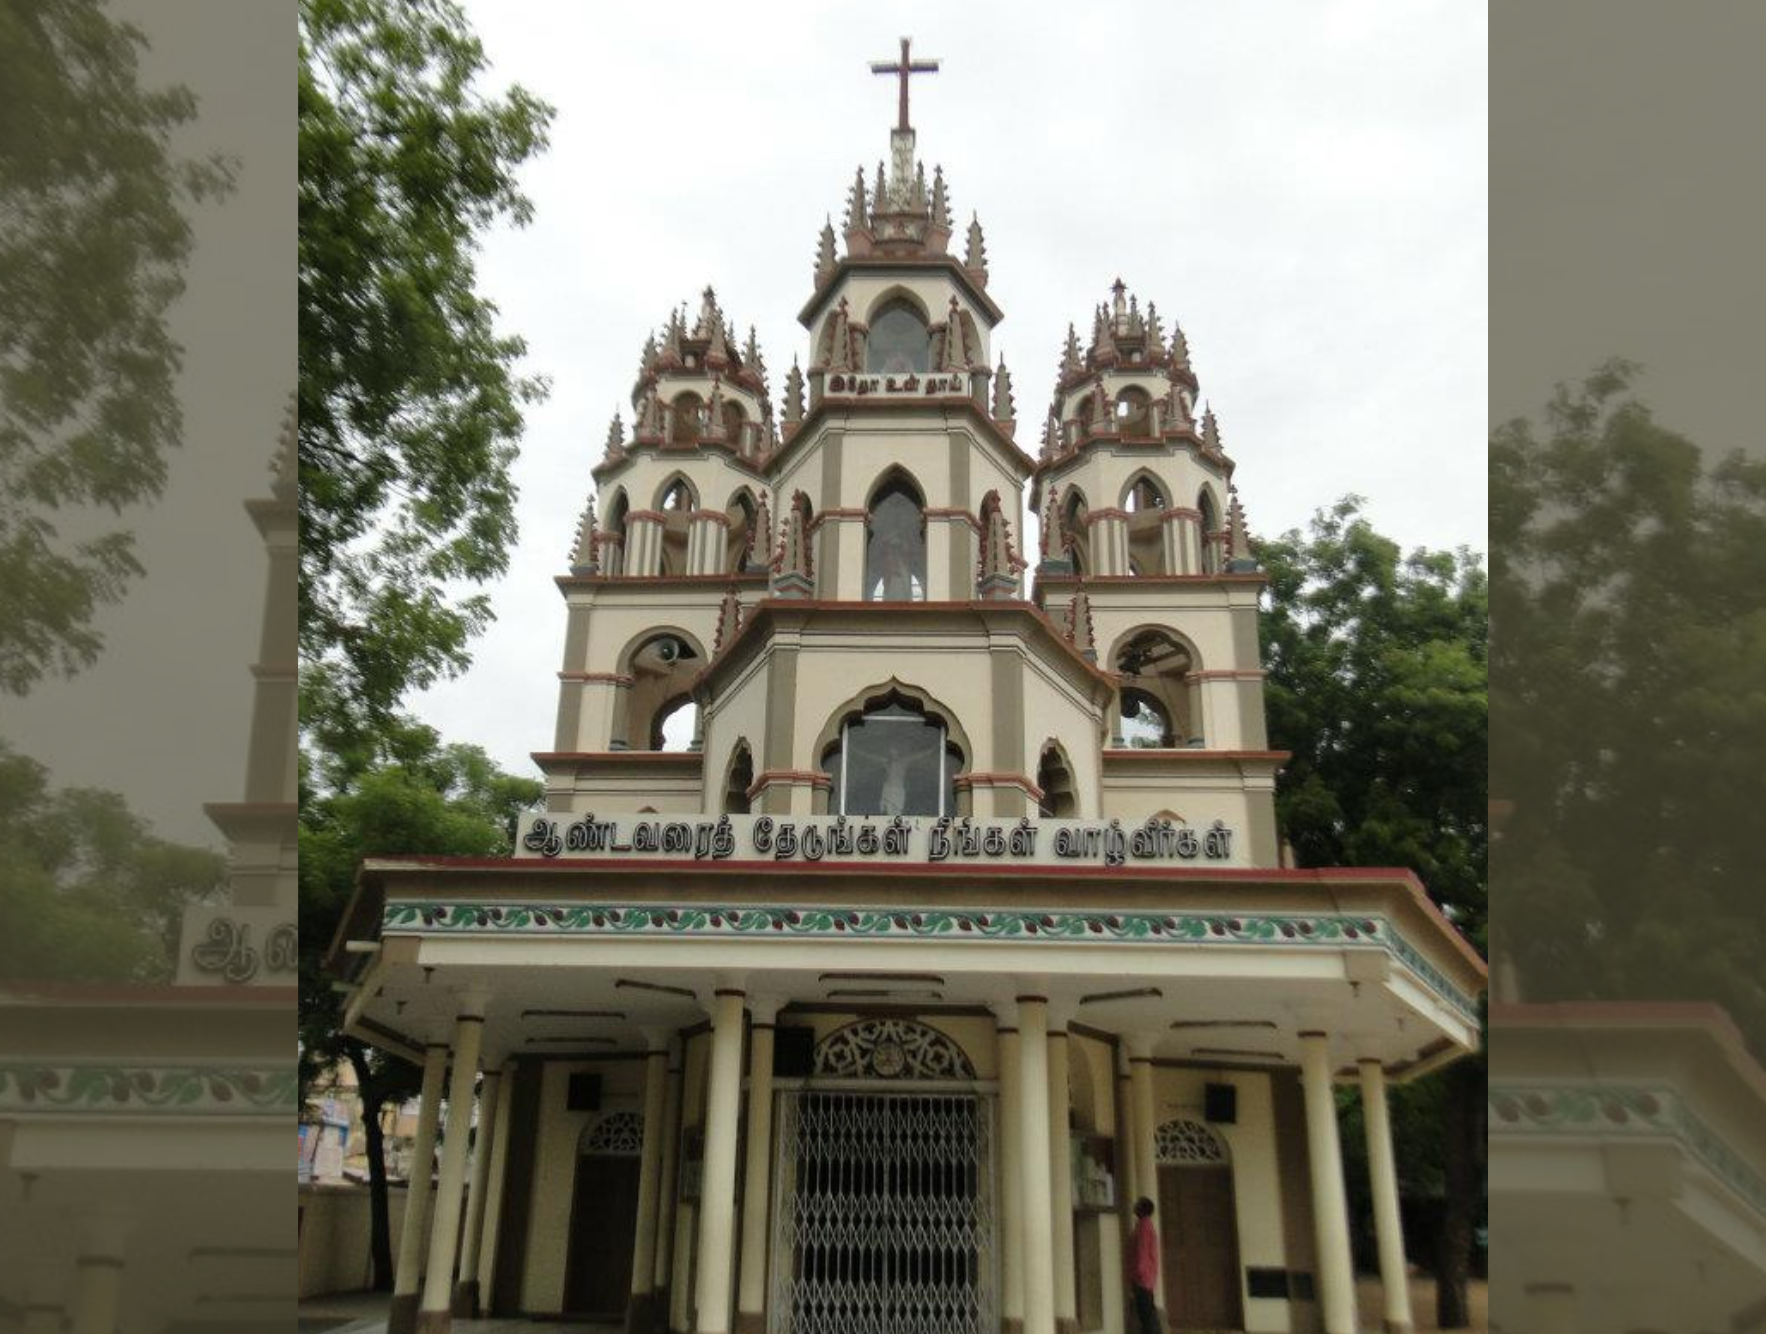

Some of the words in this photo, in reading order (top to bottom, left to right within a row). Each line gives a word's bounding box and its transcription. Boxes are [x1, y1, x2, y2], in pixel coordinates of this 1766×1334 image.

[885, 373, 920, 393] உன்
[925, 373, 962, 395] தாய்
[523, 813, 736, 861] ஆண்டவரைத்
[752, 814, 911, 862] தேடுங்கள்
[928, 815, 1039, 862] நீங்கள்
[1053, 818, 1233, 867] வாழ்வீர்கள்
